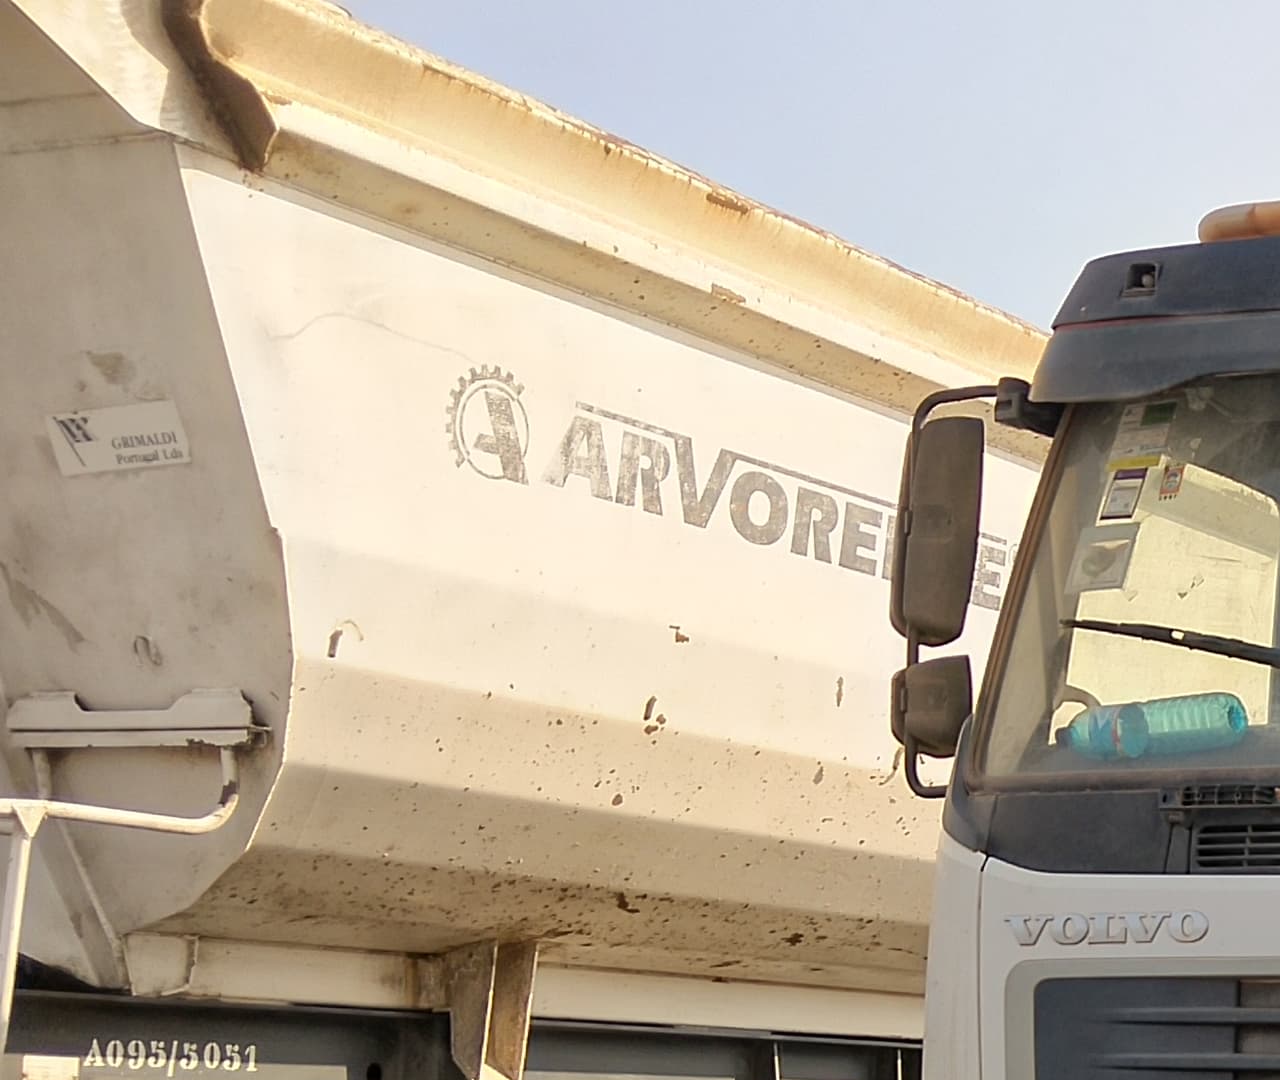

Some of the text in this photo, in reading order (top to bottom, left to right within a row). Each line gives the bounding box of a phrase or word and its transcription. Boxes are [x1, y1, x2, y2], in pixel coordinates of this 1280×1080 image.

[112, 432, 177, 450] GRIMALDI
[116, 450, 159, 465] Portugal
[541, 401, 1007, 612] ARVOREE
[1003, 912, 1210, 946] VOLVO
[83, 1038, 259, 1078] A095/5051
